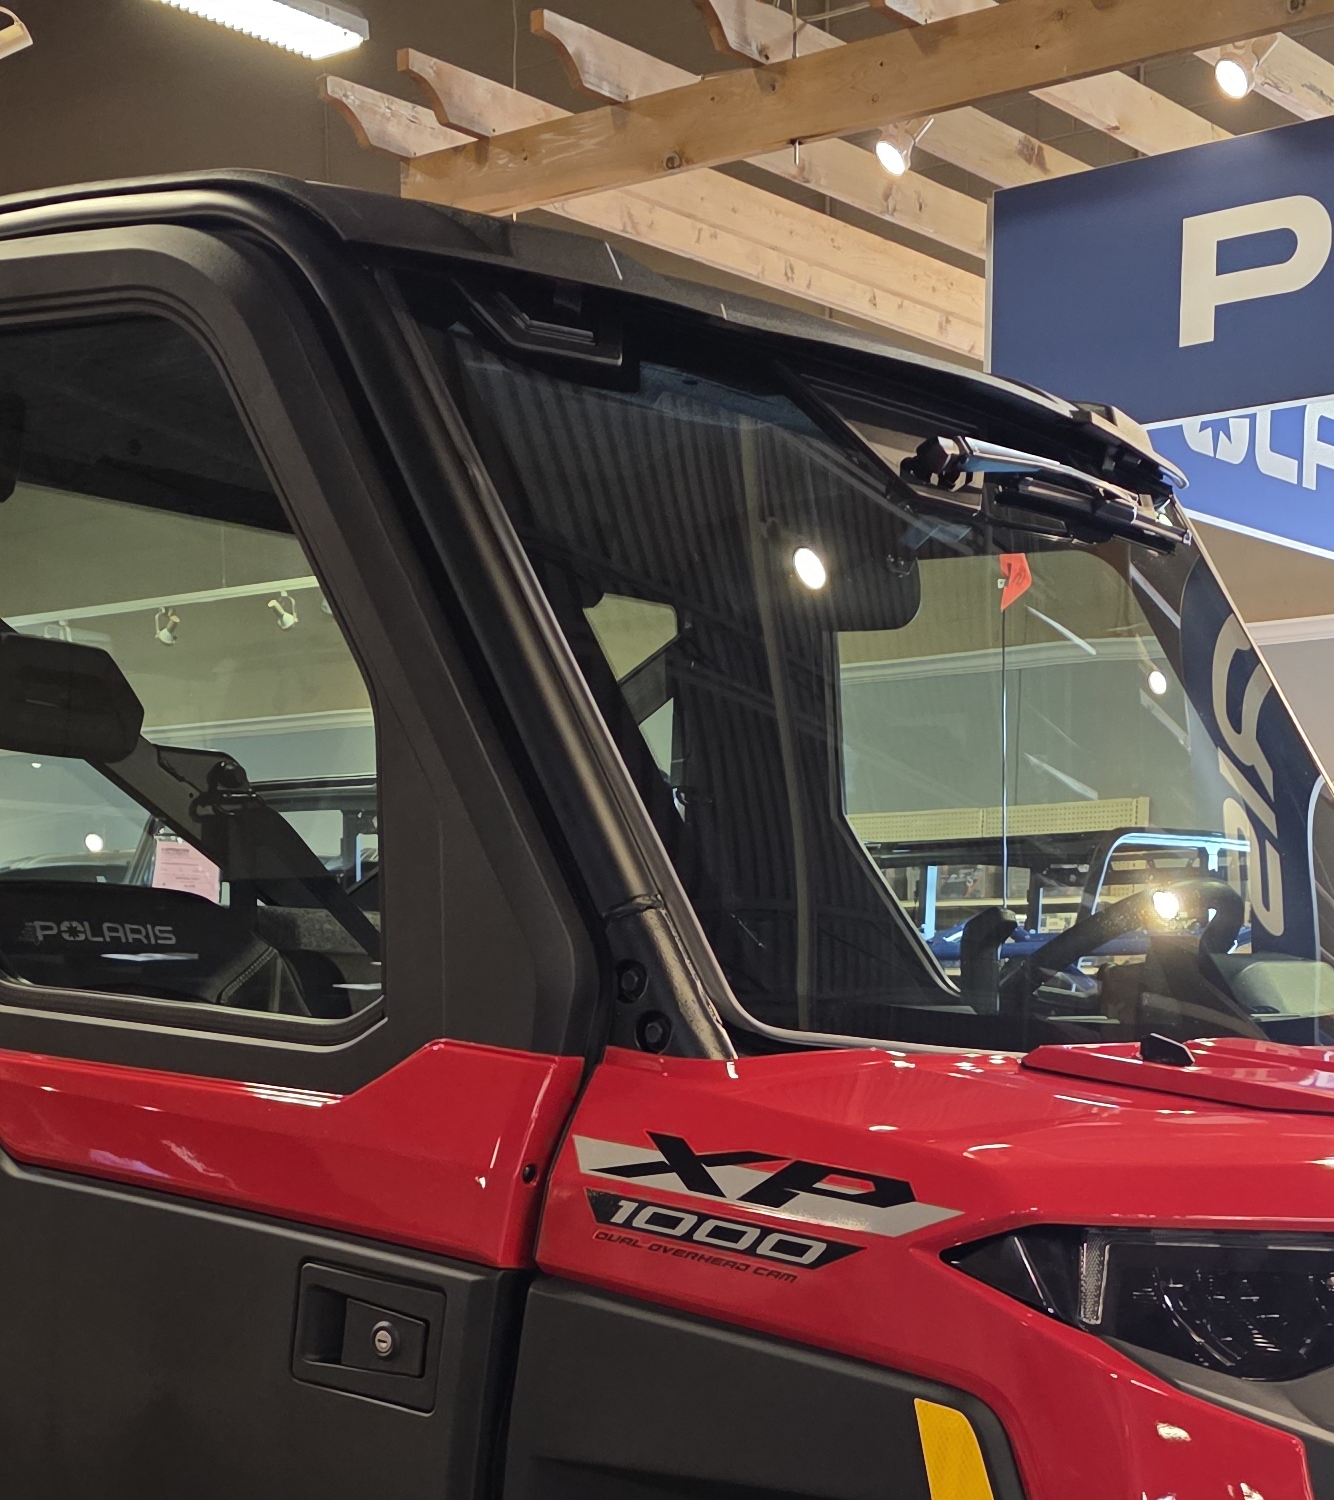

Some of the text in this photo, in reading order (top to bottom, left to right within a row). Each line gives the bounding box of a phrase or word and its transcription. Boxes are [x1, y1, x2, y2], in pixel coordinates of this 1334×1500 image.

[32, 920, 176, 945] POLARIS
[587, 1130, 917, 1209] XP
[594, 1230, 799, 1284] DUAL OVERHEAD CAM
[609, 1199, 828, 1265] 1000
